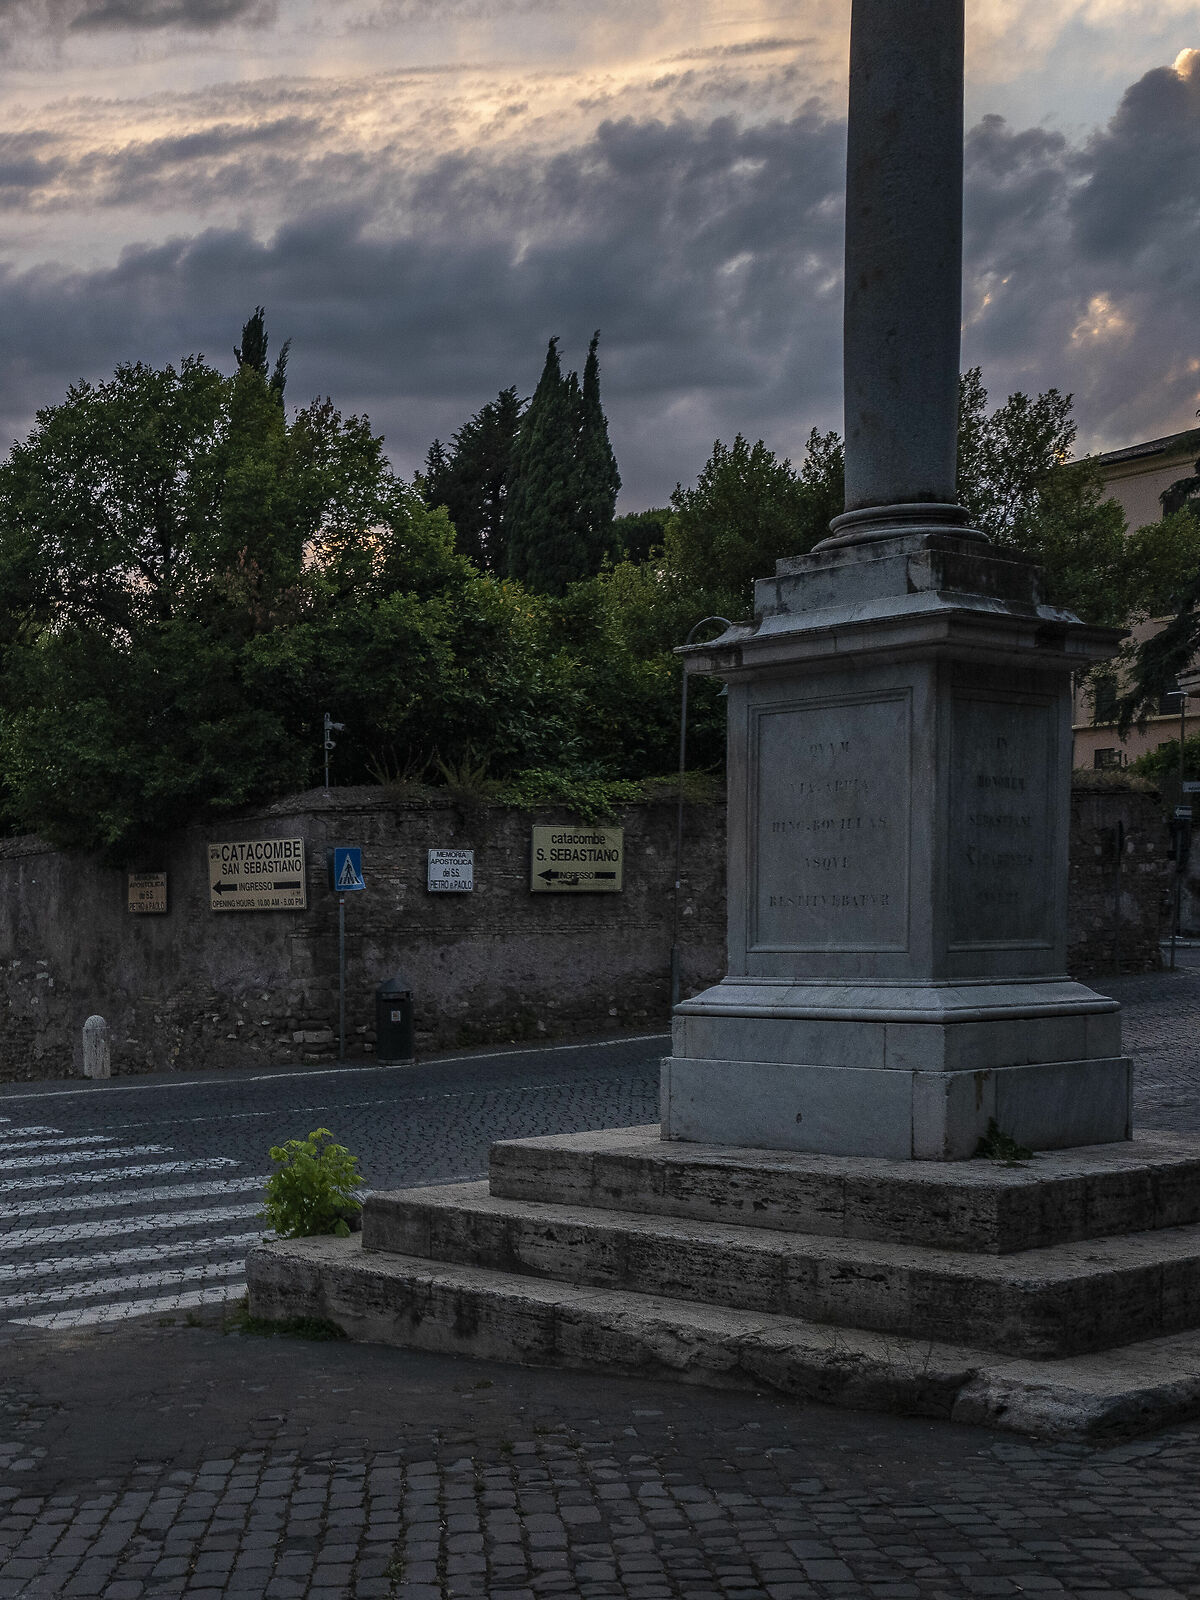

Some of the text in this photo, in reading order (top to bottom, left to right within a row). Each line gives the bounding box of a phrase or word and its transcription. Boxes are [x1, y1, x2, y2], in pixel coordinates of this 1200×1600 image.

[551, 832, 606, 845] catacombe
[221, 841, 301, 861] CATACOMBE
[536, 848, 619, 862] S. SEBASTIANO
[222, 860, 302, 875] SAN SEBASTIANO
[560, 871, 594, 880] INGRESSO
[239, 881, 273, 891] INGRESSO
